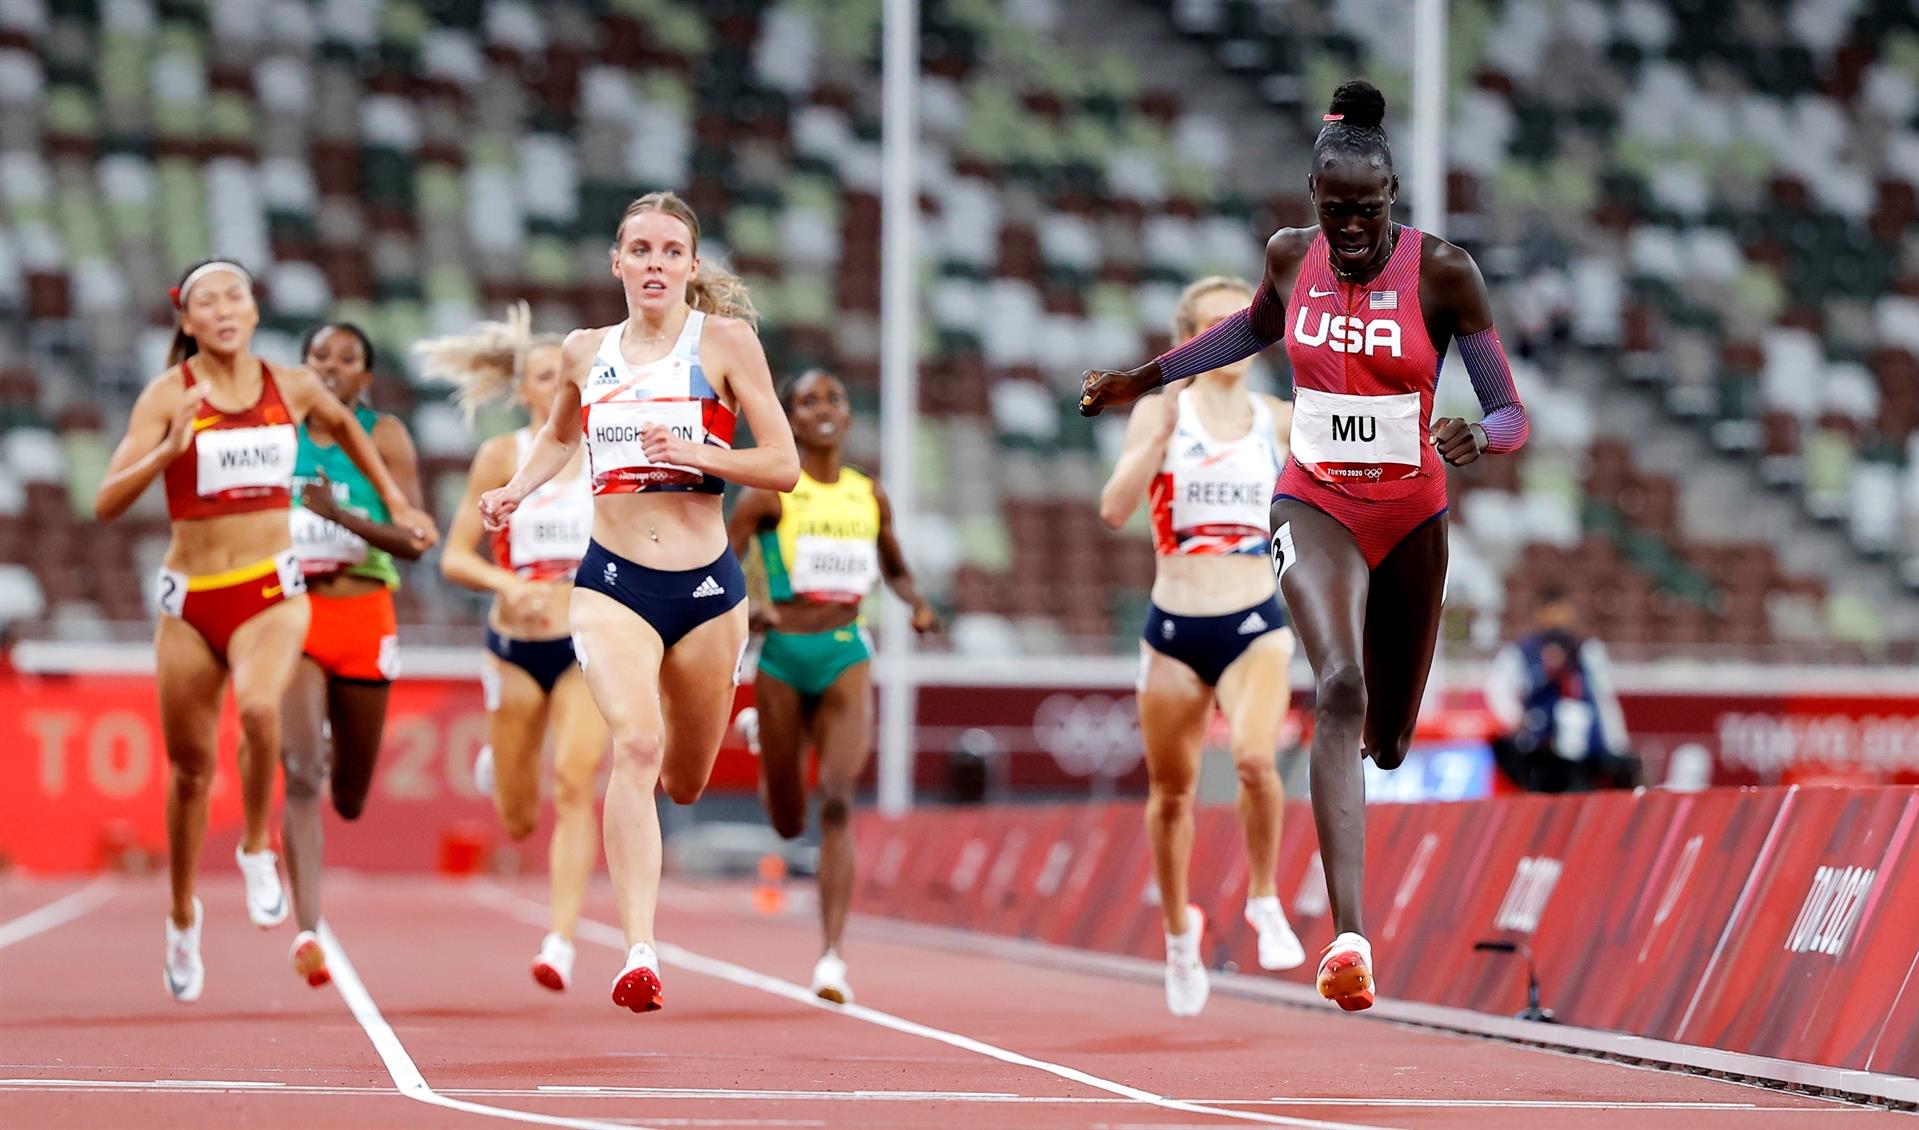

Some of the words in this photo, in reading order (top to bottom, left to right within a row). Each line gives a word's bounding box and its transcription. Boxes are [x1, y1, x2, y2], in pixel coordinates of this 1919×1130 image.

[1294, 306, 1402, 357] USA
[1332, 415, 1376, 442] MU
[218, 444, 280, 468] WANG
[1328, 468, 1346, 476] TOKYO
[1187, 482, 1263, 506] REEKIE
[535, 520, 580, 542] BELL
[163, 576, 176, 611] 2
